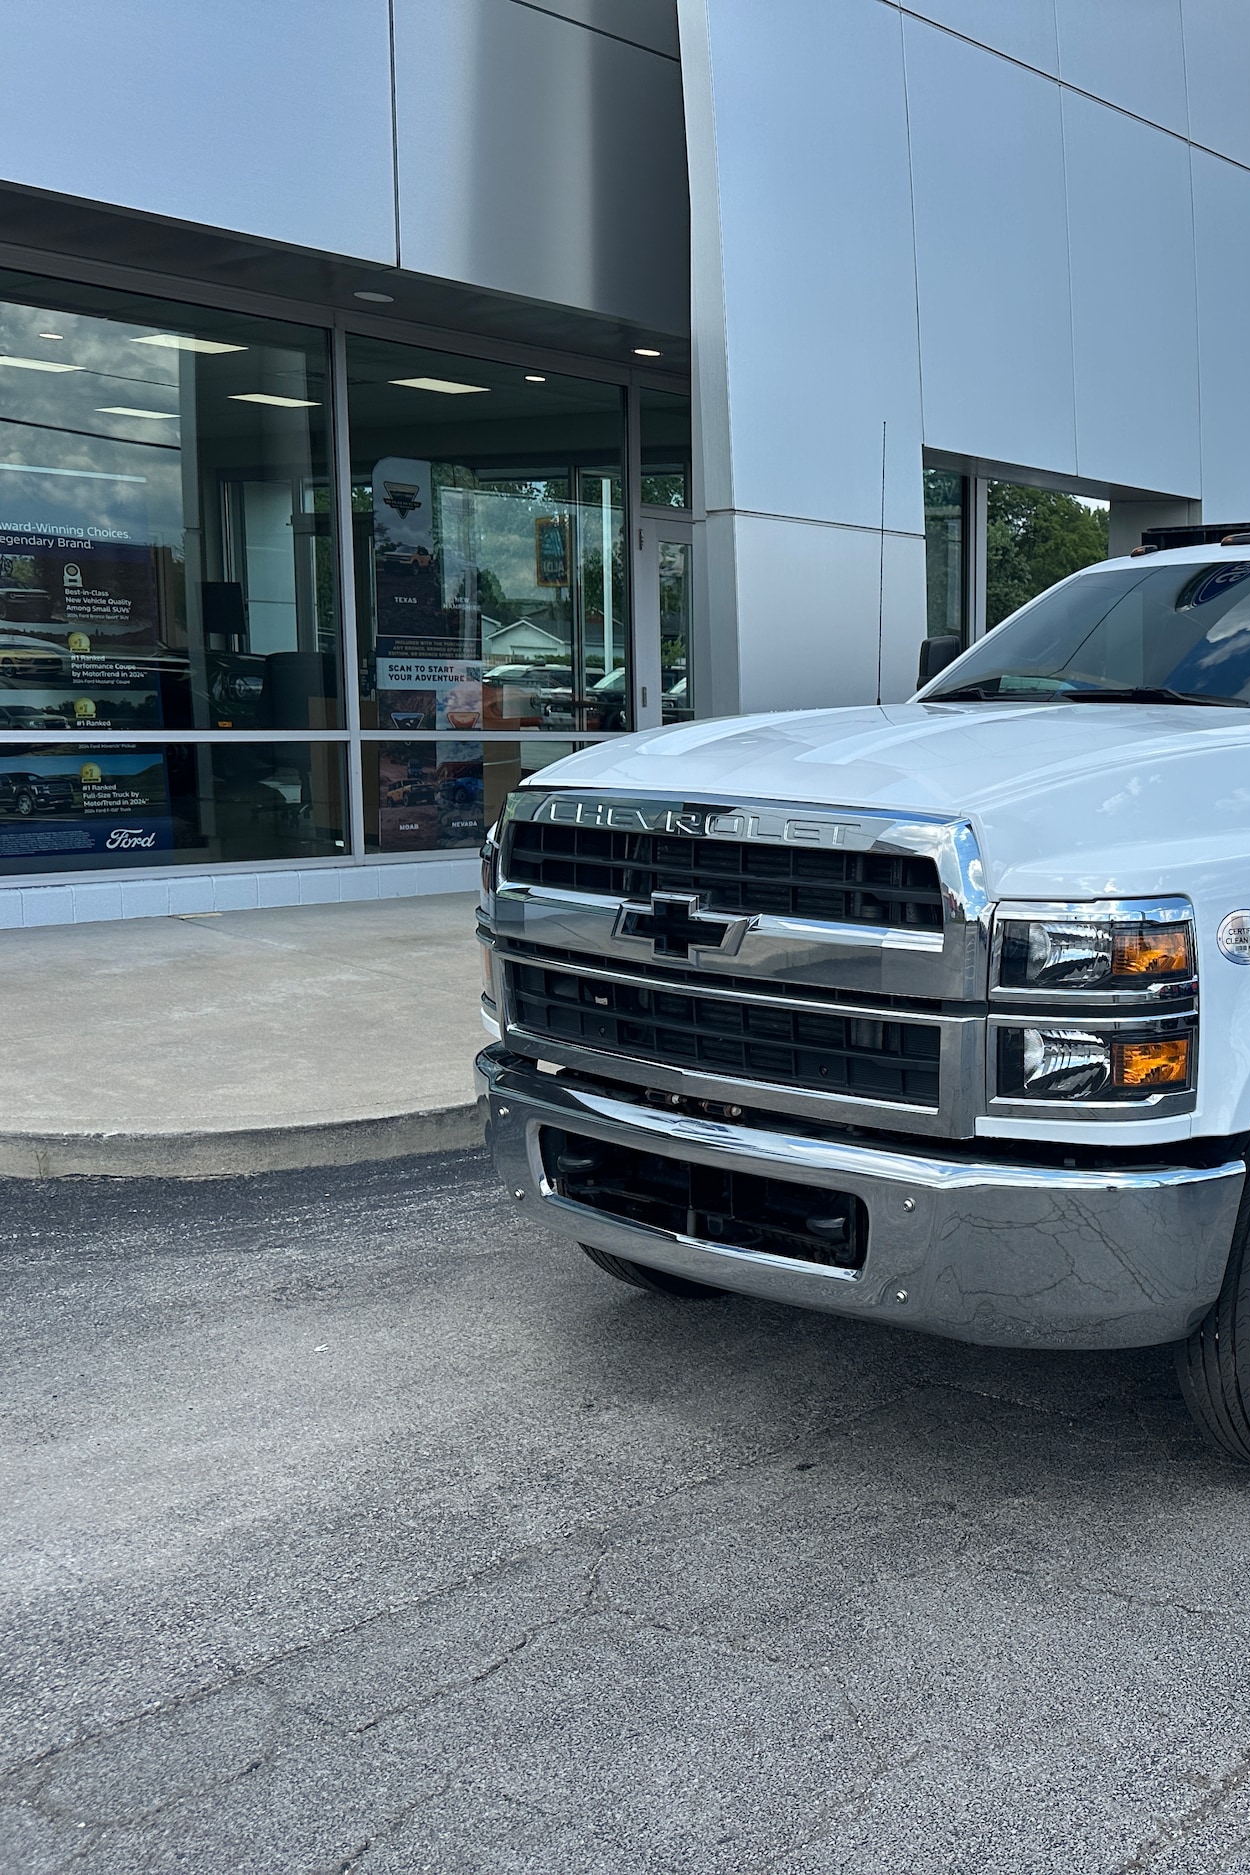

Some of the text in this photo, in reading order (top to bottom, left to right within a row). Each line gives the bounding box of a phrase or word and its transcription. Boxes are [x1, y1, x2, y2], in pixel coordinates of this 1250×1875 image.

[87, 527, 131, 539] Choices.
[58, 537, 94, 550] Brand.
[64, 588, 109, 597] Best-in-Class
[83, 597, 107, 605] Vehicle
[108, 598, 131, 606] Quality
[394, 596, 417, 604] TEXAS
[66, 604, 91, 613] Among
[388, 673, 465, 682] YOUR ADVENTURE
[399, 823, 419, 831] MOAB
[549, 801, 862, 847] CHEVROLET
[106, 828, 156, 849] Ford
[1225, 937, 1248, 945] CLEAN
